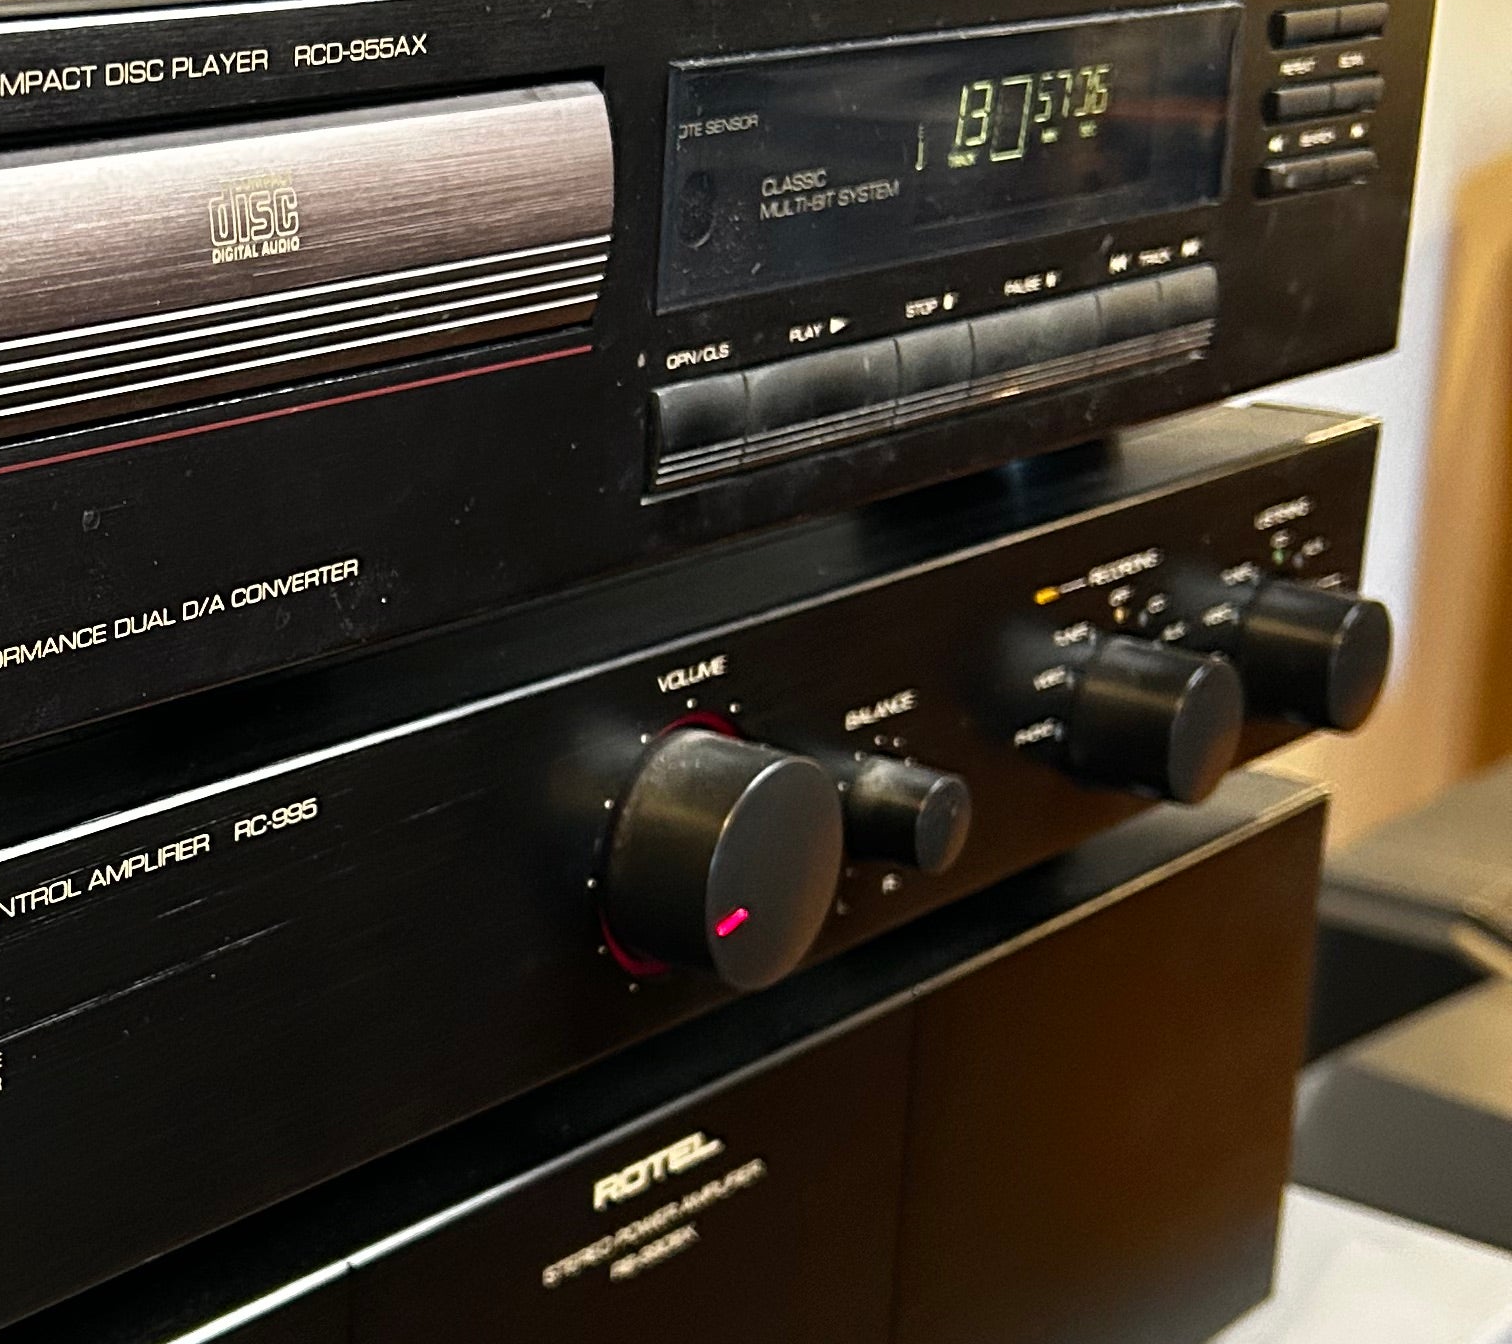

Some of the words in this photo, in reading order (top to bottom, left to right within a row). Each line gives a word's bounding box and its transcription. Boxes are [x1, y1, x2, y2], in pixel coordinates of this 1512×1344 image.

[105, 60, 164, 86] DISC
[172, 49, 269, 80] PLAYER
[294, 33, 428, 67] RCD-955AX
[705, 114, 759, 136] SENSOR
[760, 190, 836, 220] MULTI-BIT
[838, 179, 900, 207] SYSTEM
[762, 168, 827, 197] CLASSIC
[212, 242, 258, 264] DIGITAL
[262, 236, 300, 256] AUDIO
[789, 321, 824, 344] PLAY
[666, 341, 730, 370] OPN/CLS
[114, 608, 176, 639] DUAL
[183, 595, 225, 622] D/A
[231, 558, 359, 609] CONVERTER
[657, 654, 728, 693] VOLUME
[845, 688, 918, 731] BALANCE
[88, 833, 210, 891] AMPLIFIER
[234, 797, 318, 842] RC-995
[593, 1131, 726, 1211] ROTEL
